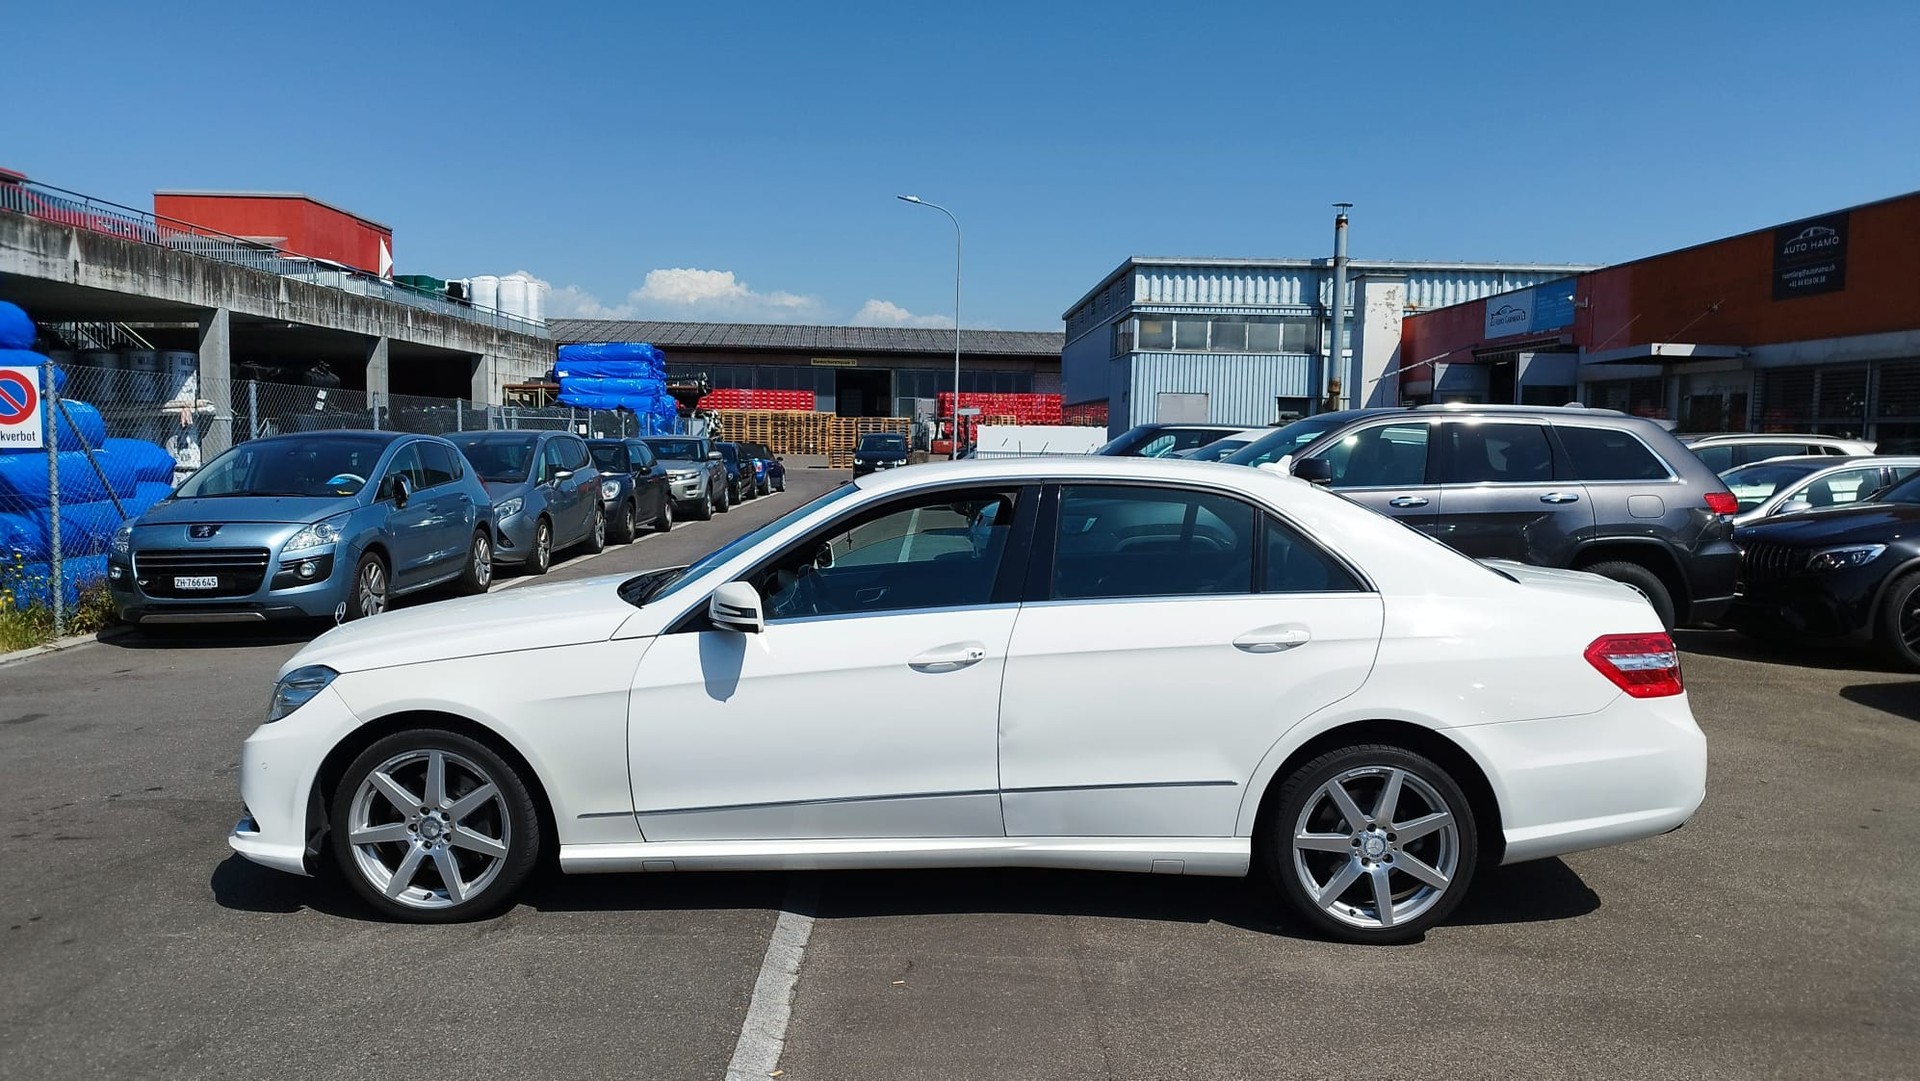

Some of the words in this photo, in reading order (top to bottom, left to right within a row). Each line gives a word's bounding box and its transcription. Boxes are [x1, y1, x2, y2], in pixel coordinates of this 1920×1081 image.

[1784, 243, 1807, 254] AUTO
[1810, 236, 1839, 249] HAMO
[0, 430, 36, 441] kverbot
